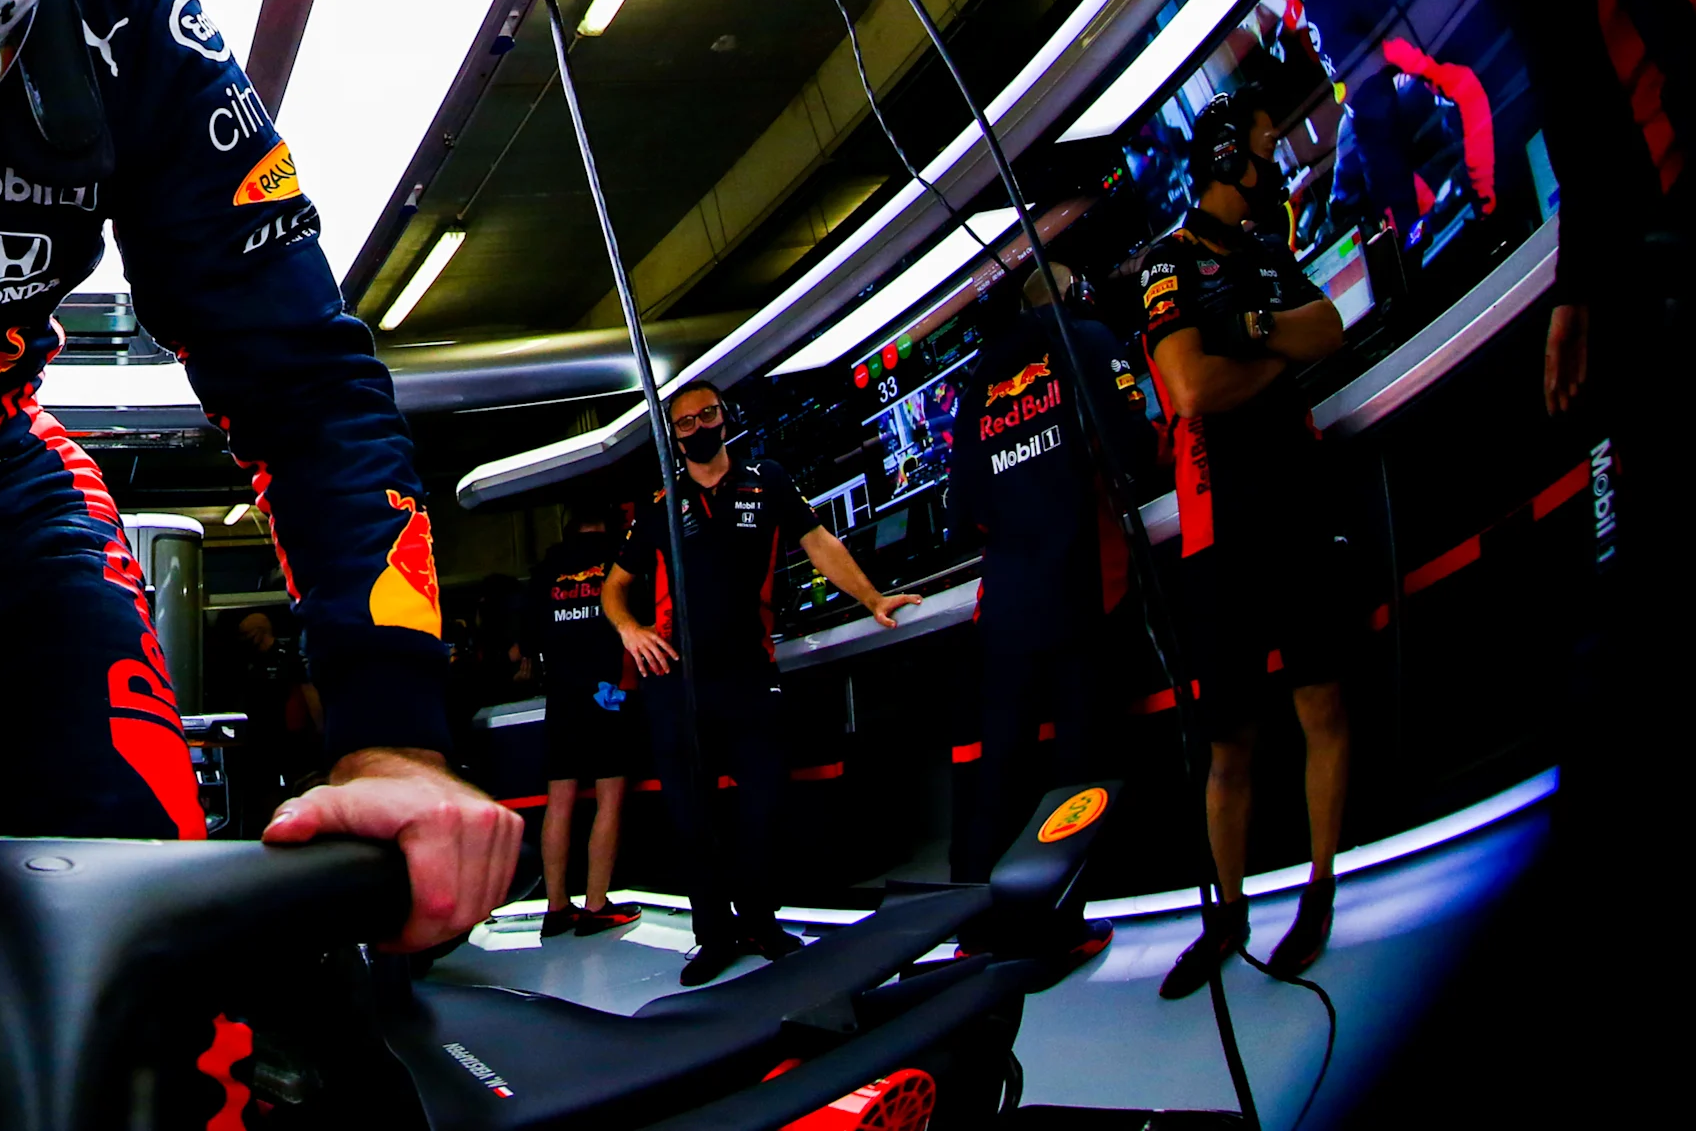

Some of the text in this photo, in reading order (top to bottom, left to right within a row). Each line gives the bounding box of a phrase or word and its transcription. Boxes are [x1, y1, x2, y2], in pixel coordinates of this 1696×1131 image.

[1150, 263, 1175, 276] AT&T
[877, 376, 898, 403] 33
[979, 400, 1021, 441] Red
[1021, 379, 1061, 421] Bull
[991, 434, 1041, 475] Mobil
[1590, 437, 1616, 538] Mobil
[735, 501, 755, 510] Mobil
[551, 581, 604, 601] Red Bu
[554, 606, 589, 622] Mobil
